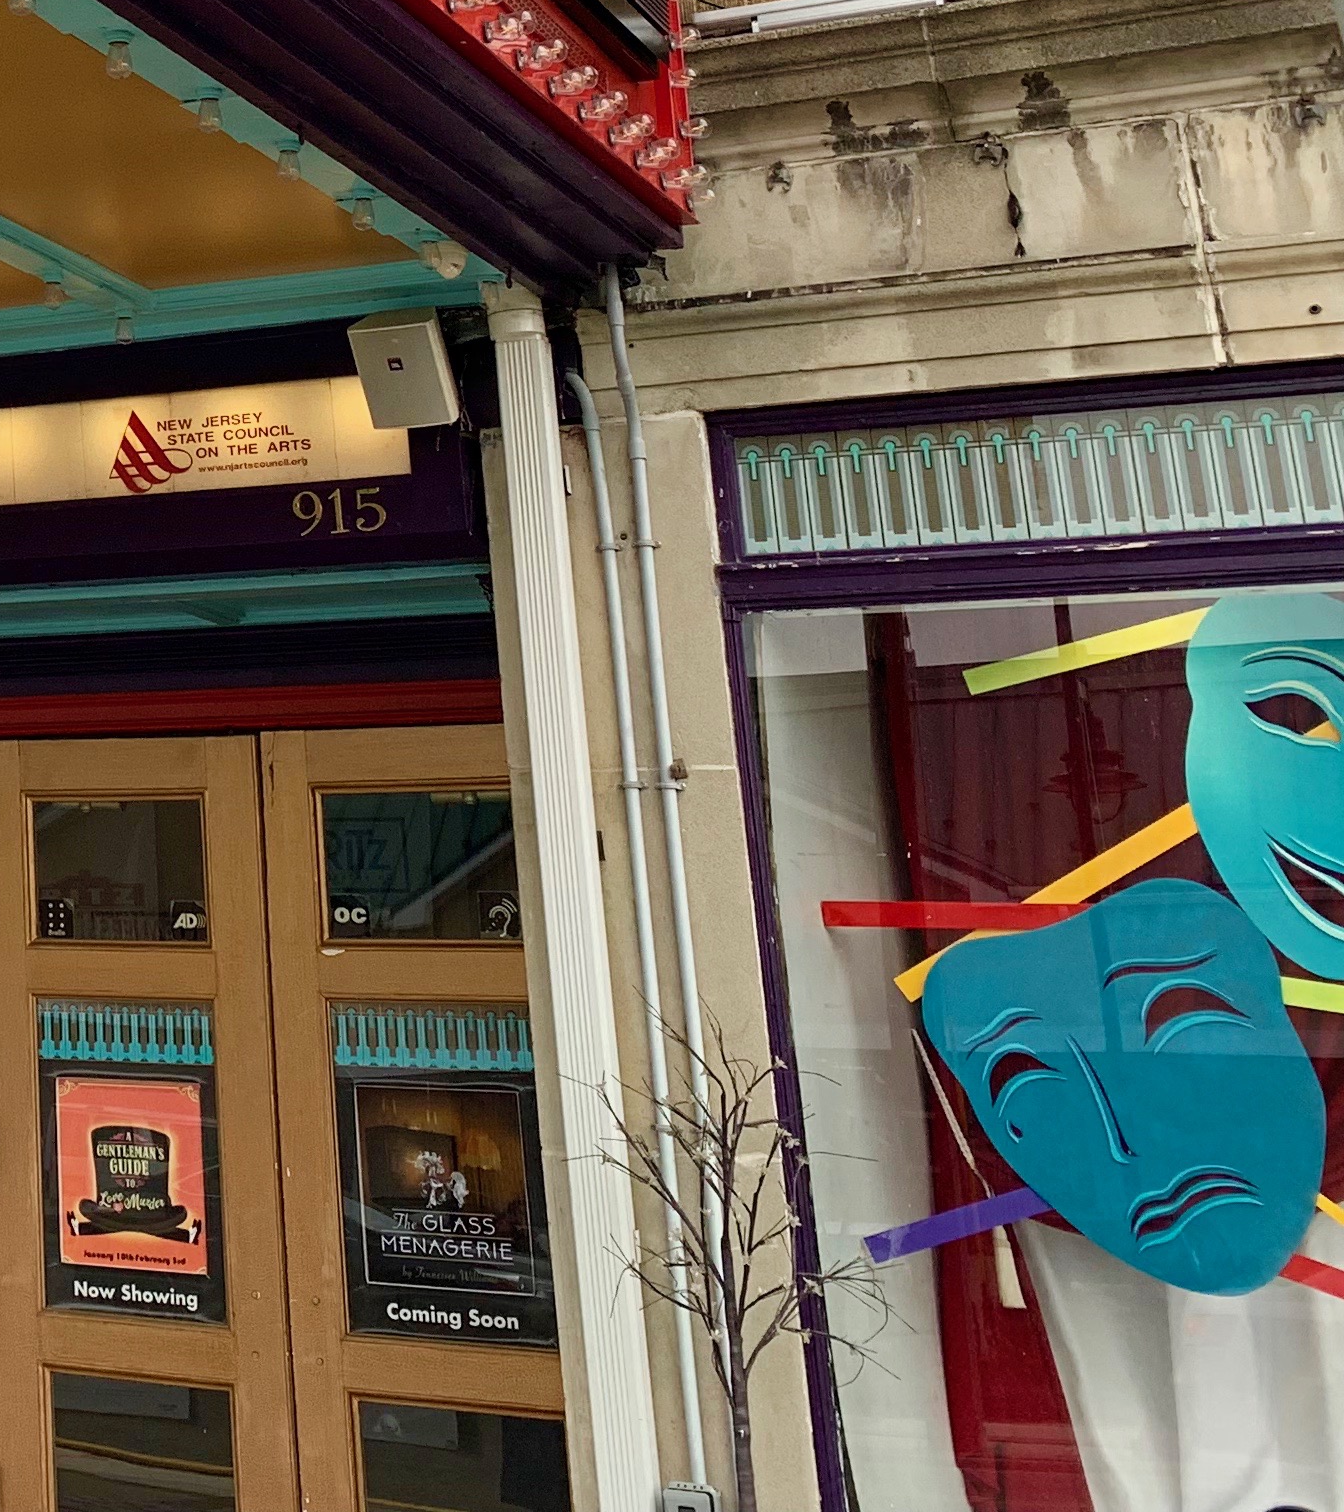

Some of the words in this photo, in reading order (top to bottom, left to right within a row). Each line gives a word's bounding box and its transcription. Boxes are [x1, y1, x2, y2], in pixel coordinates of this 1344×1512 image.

[157, 418, 193, 432] NEW
[202, 412, 263, 428] JERSEY
[167, 432, 215, 446] STATE
[223, 424, 295, 441] COUNCIL
[196, 446, 219, 459] ON
[229, 443, 259, 456] THE
[268, 439, 312, 454] ARTS
[198, 457, 308, 473] www.njartscouncil.org
[292, 487, 387, 537] 915
[334, 907, 367, 924] OC
[125, 1131, 132, 1141] A
[96, 1144, 165, 1161] GENTLEMAN'S
[109, 1159, 150, 1176] GUIDE
[125, 1178, 135, 1188] TO
[99, 1190, 124, 1208] Love
[124, 1193, 165, 1210] Murder
[392, 1212, 417, 1231] The
[422, 1214, 496, 1235] GLASS
[84, 1250, 114, 1262] January
[381, 1235, 513, 1261] MENAGERIE
[402, 1265, 412, 1280] by
[74, 1280, 115, 1300] Now
[121, 1284, 198, 1311] Showing
[386, 1303, 462, 1330] Coming
[468, 1308, 520, 1330] Soon
